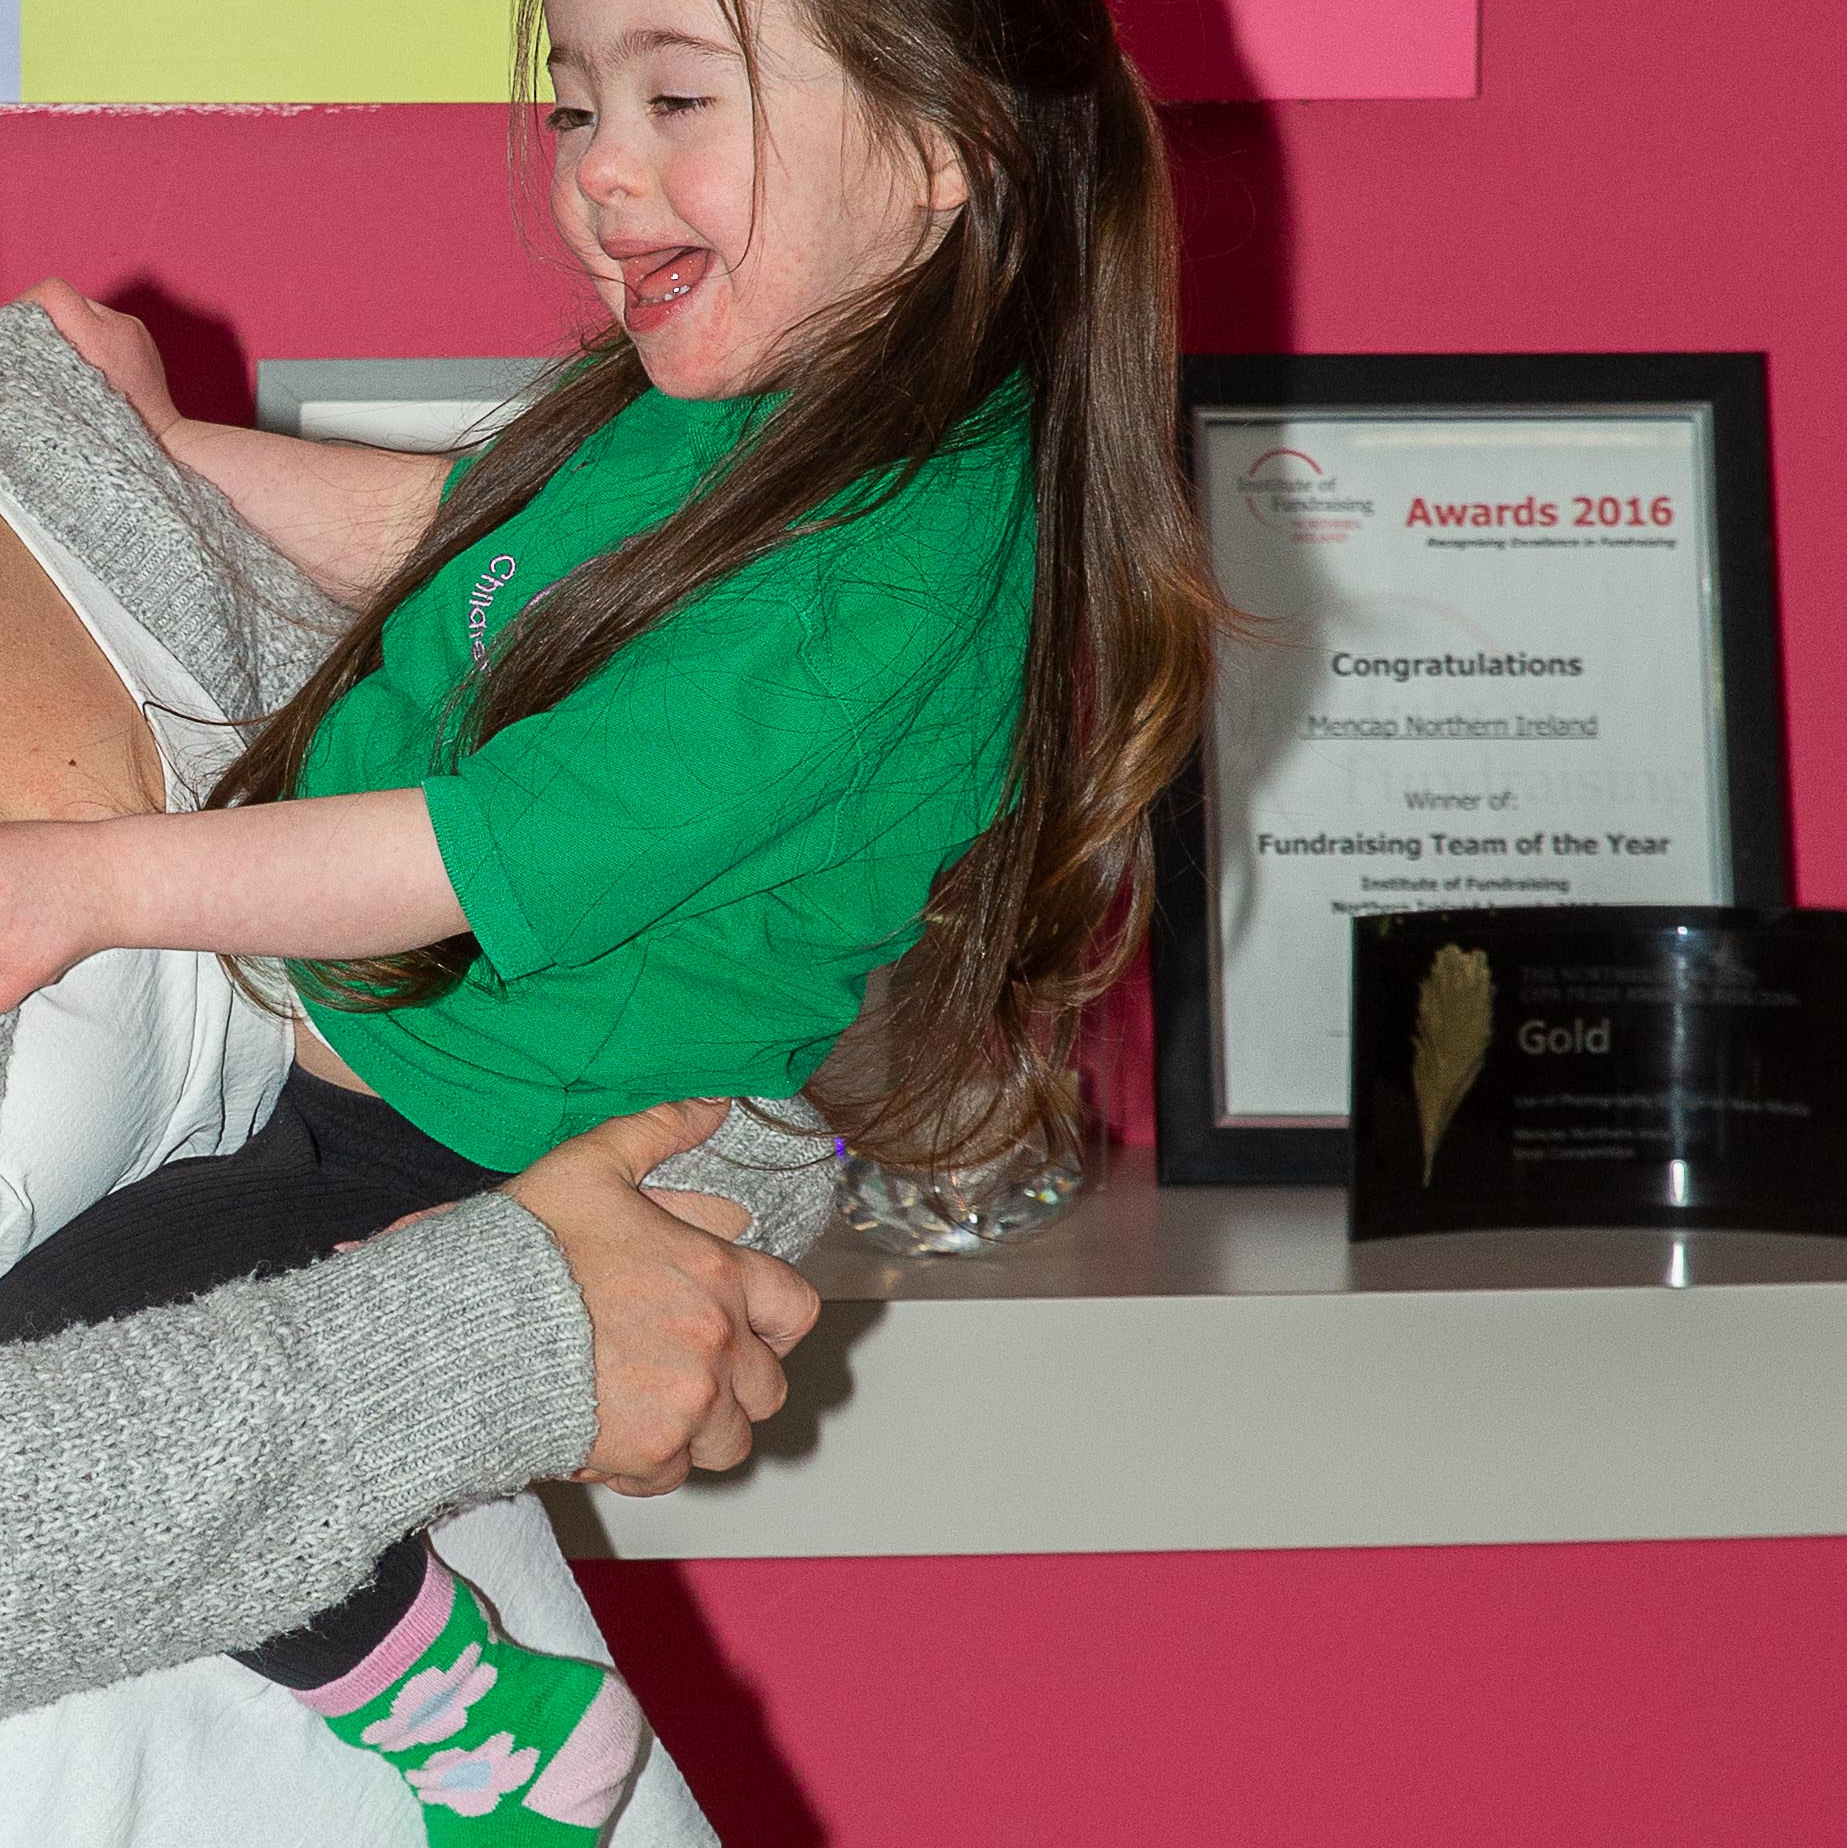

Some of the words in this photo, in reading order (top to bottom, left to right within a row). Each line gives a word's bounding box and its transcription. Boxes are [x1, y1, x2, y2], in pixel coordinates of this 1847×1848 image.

[1405, 495, 1559, 528] Awards
[1572, 496, 1674, 528] 2016
[1332, 652, 1583, 683] Congratulations
[1307, 715, 1398, 740] Mencap
[1406, 715, 1509, 738] Northern
[1516, 715, 1598, 738] Ireland
[1404, 791, 1482, 812] Winner
[1489, 790, 1520, 812] of:
[1257, 834, 1421, 861] Fundraising
[1429, 834, 1509, 855] Team
[1515, 834, 1545, 855] of
[1552, 834, 1598, 855] the
[1605, 834, 1672, 855] Year
[1360, 877, 1439, 892] Institute
[1443, 877, 1464, 892] of
[1465, 877, 1571, 894] Fundraising
[1518, 1016, 1611, 1054] Gold
